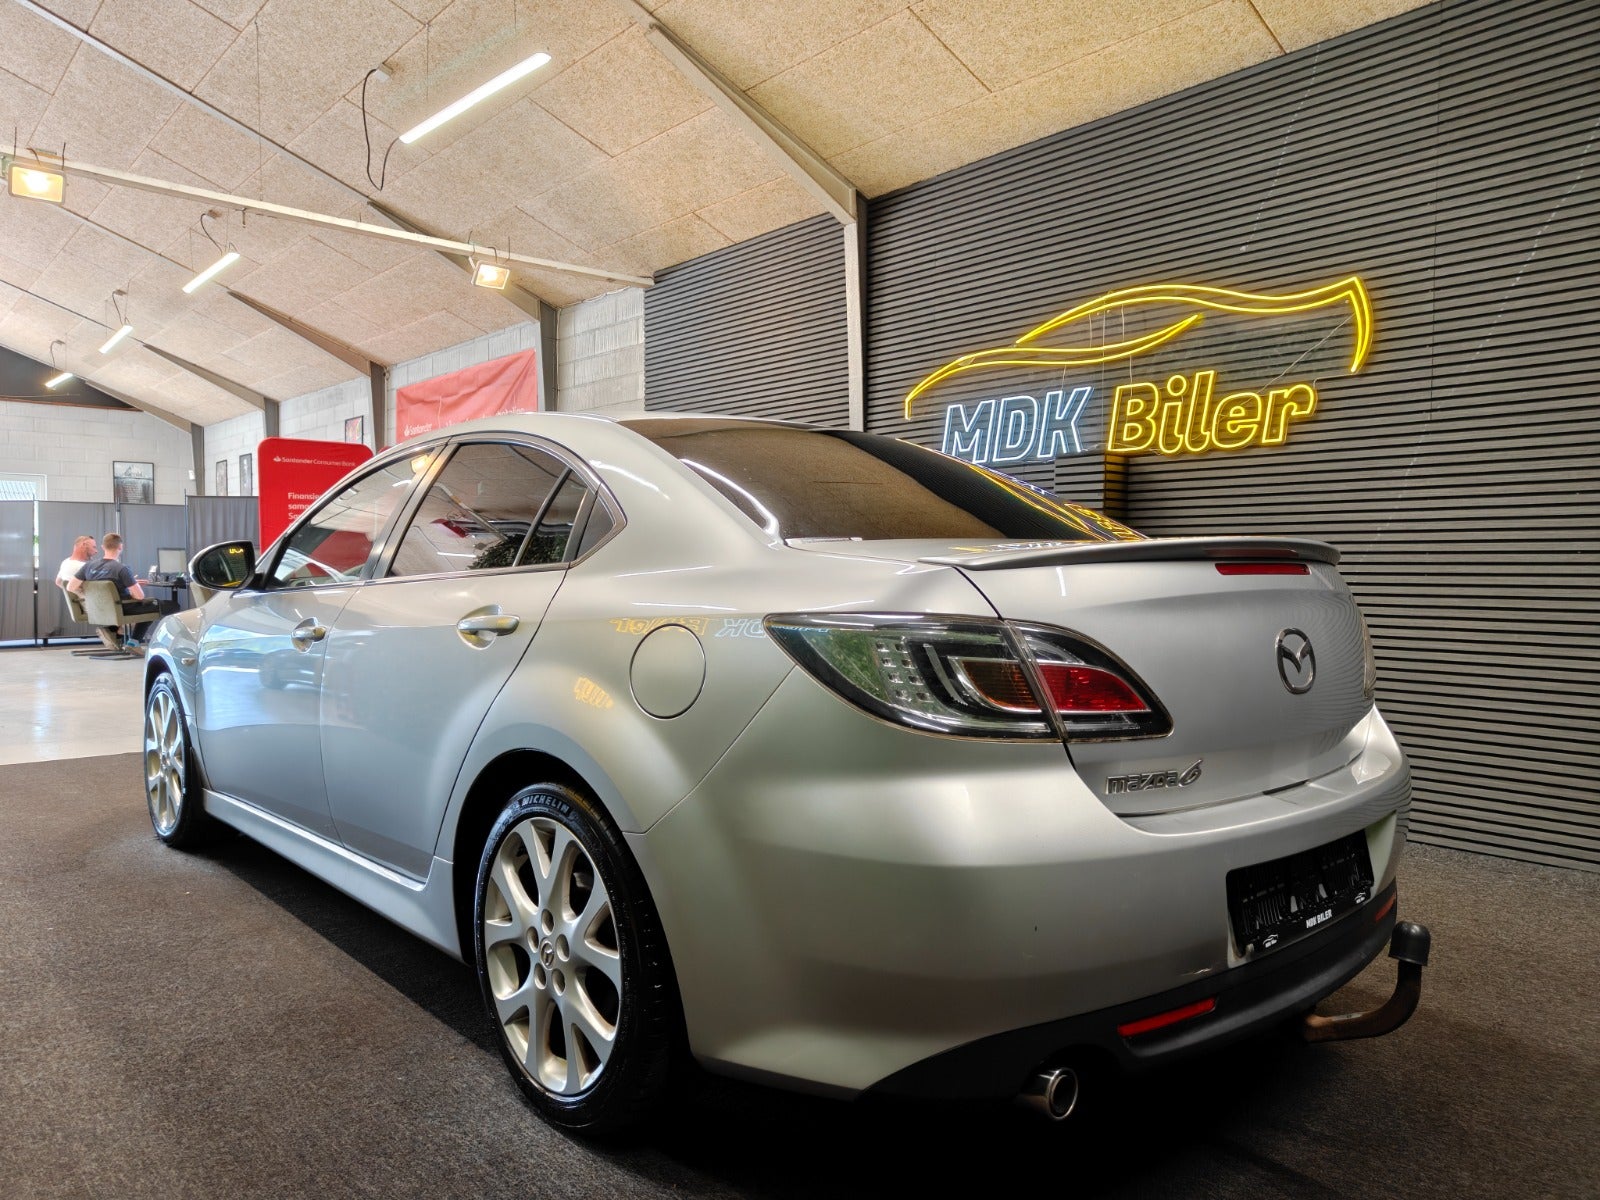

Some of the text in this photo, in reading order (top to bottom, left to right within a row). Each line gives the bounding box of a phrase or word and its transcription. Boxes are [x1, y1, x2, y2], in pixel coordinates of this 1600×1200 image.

[941, 370, 1318, 465] MDK Biler
[281, 456, 313, 464] Santander
[313, 458, 341, 466] Consumer
[522, 794, 570, 815] MICHELIN
